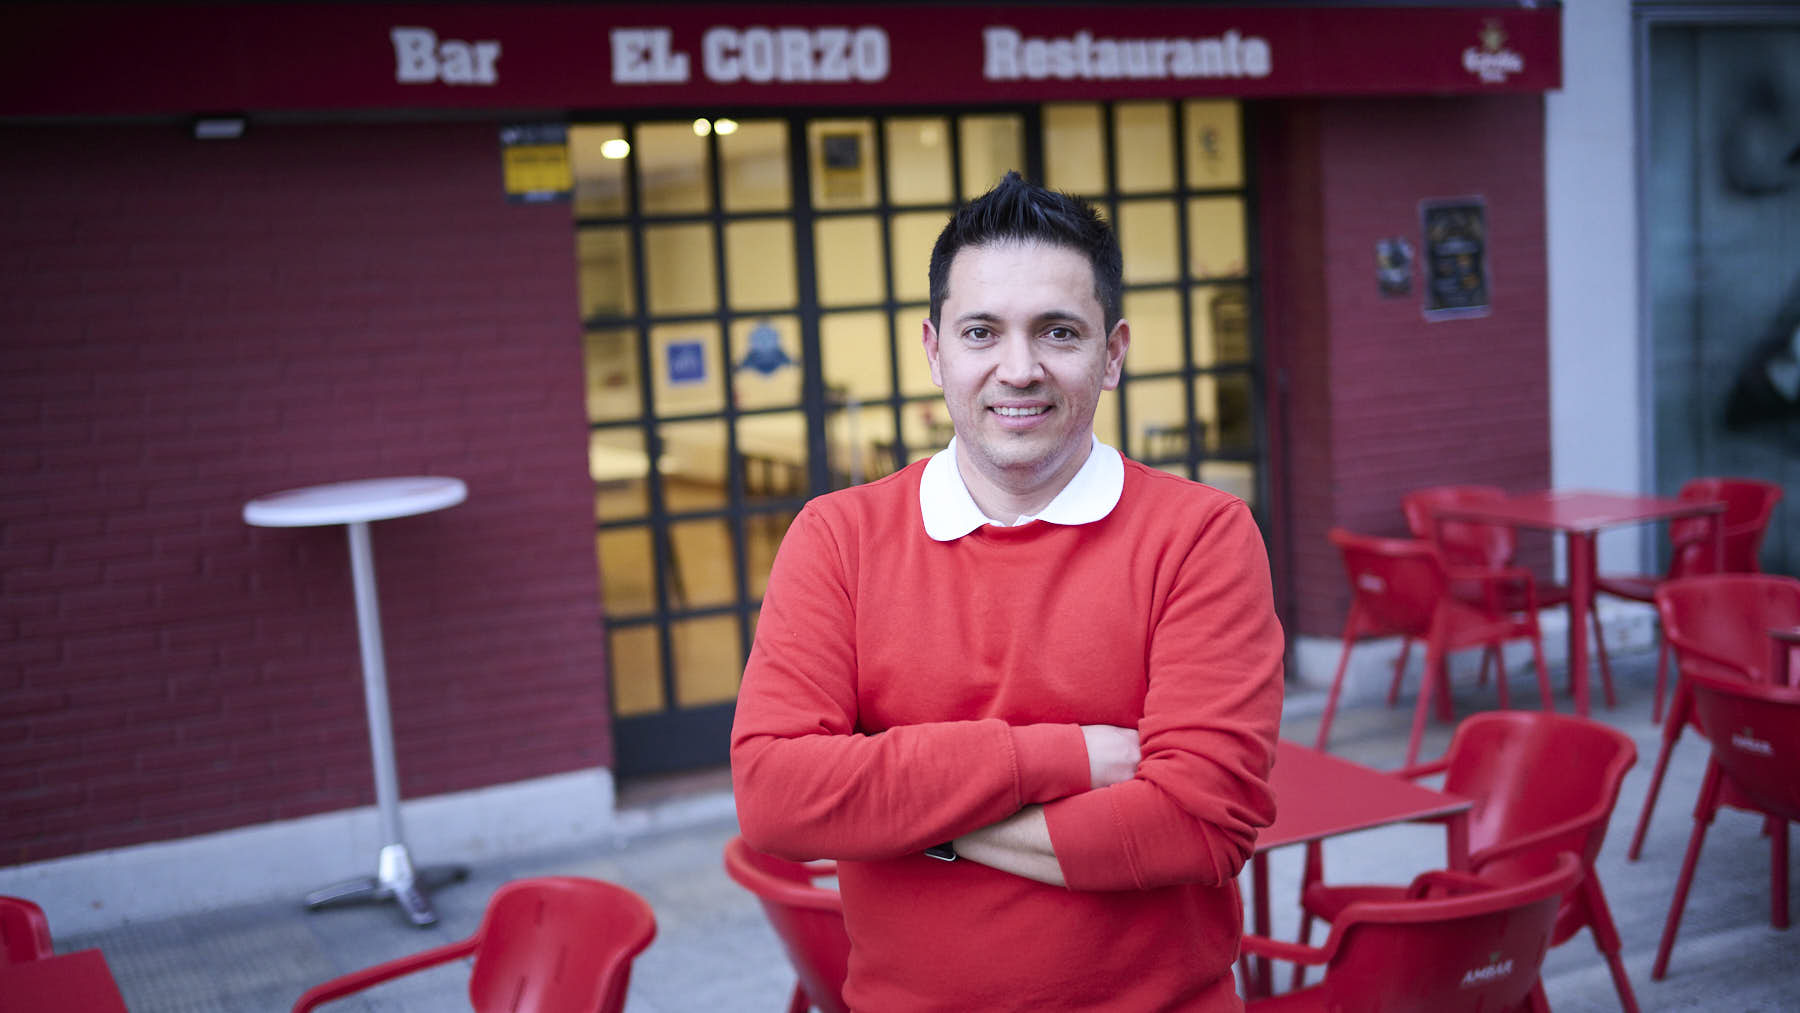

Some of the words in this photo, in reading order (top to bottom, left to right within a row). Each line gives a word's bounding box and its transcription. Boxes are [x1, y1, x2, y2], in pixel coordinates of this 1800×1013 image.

[392, 28, 500, 85] Bar
[611, 29, 690, 84] EL
[703, 28, 889, 83] CORZO
[984, 28, 1271, 81] Restaurante
[1461, 960, 1513, 987] AMBAR
